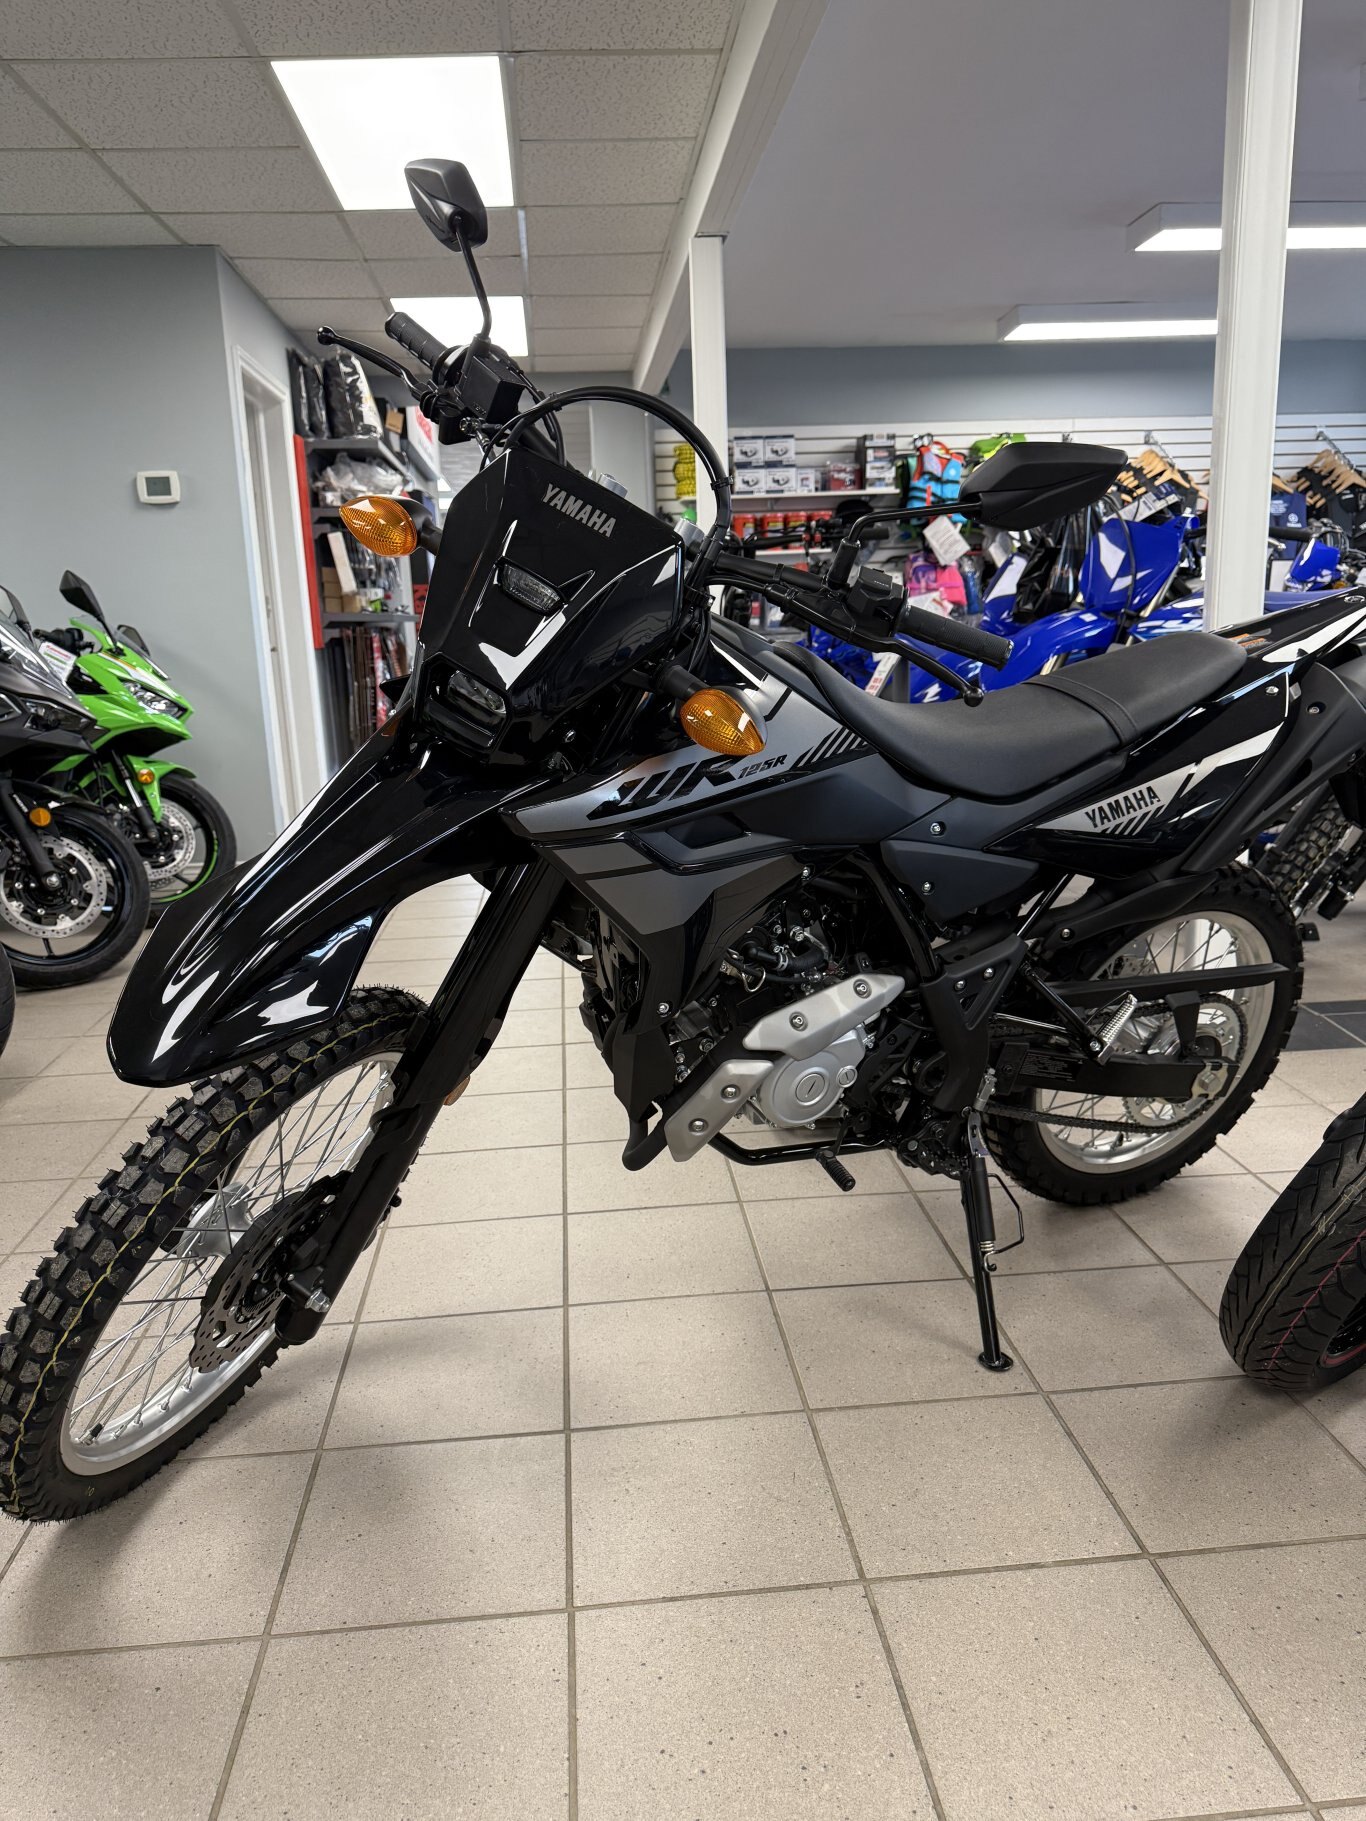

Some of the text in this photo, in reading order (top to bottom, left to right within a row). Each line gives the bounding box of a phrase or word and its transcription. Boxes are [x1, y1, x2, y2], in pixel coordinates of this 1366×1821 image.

[542, 483, 617, 538] YAMAHA
[586, 754, 788, 821] WR 125R
[1085, 786, 1161, 829] YAMAHA
